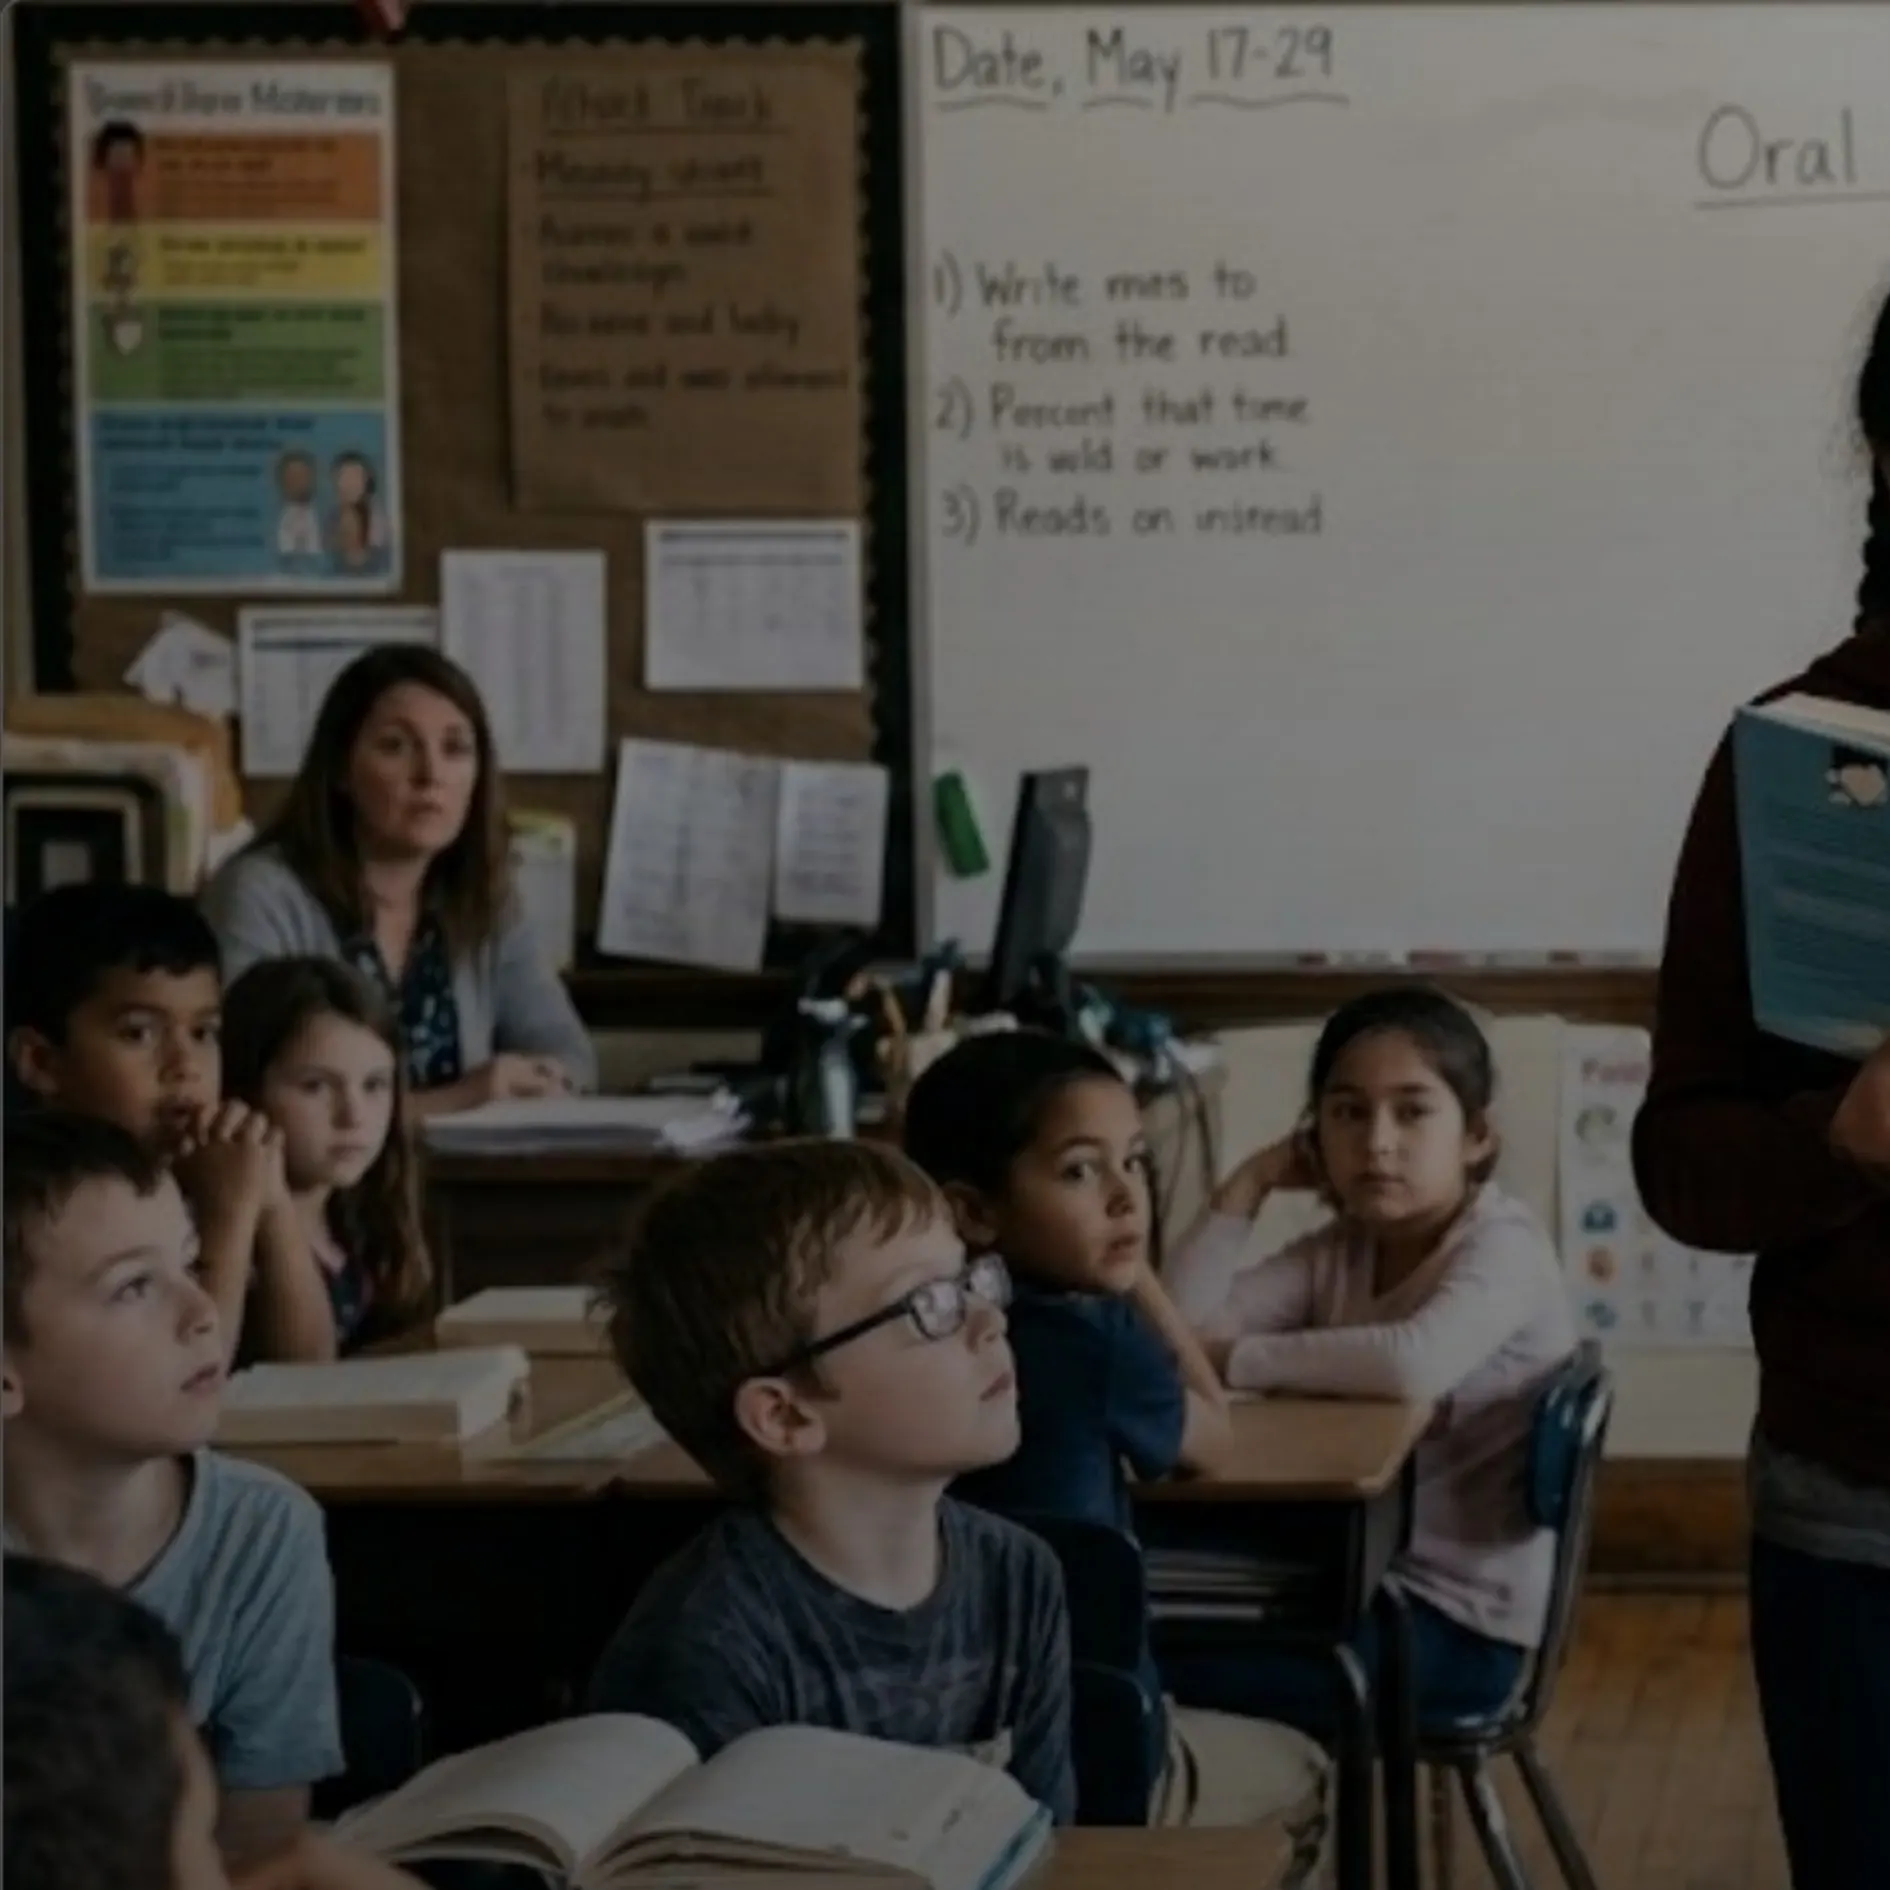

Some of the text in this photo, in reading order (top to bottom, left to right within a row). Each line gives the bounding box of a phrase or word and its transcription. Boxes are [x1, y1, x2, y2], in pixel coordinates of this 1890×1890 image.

[1086, 26, 1181, 113] May
[1206, 24, 1334, 82] 17-29
[1700, 103, 1858, 191] Oral
[933, 248, 963, 319] 1)
[975, 259, 1080, 307] Write
[1213, 258, 1258, 301] to
[990, 314, 1289, 365] from the read
[936, 374, 975, 441] 2)
[1142, 385, 1214, 425] that
[940, 482, 982, 548] 3)
